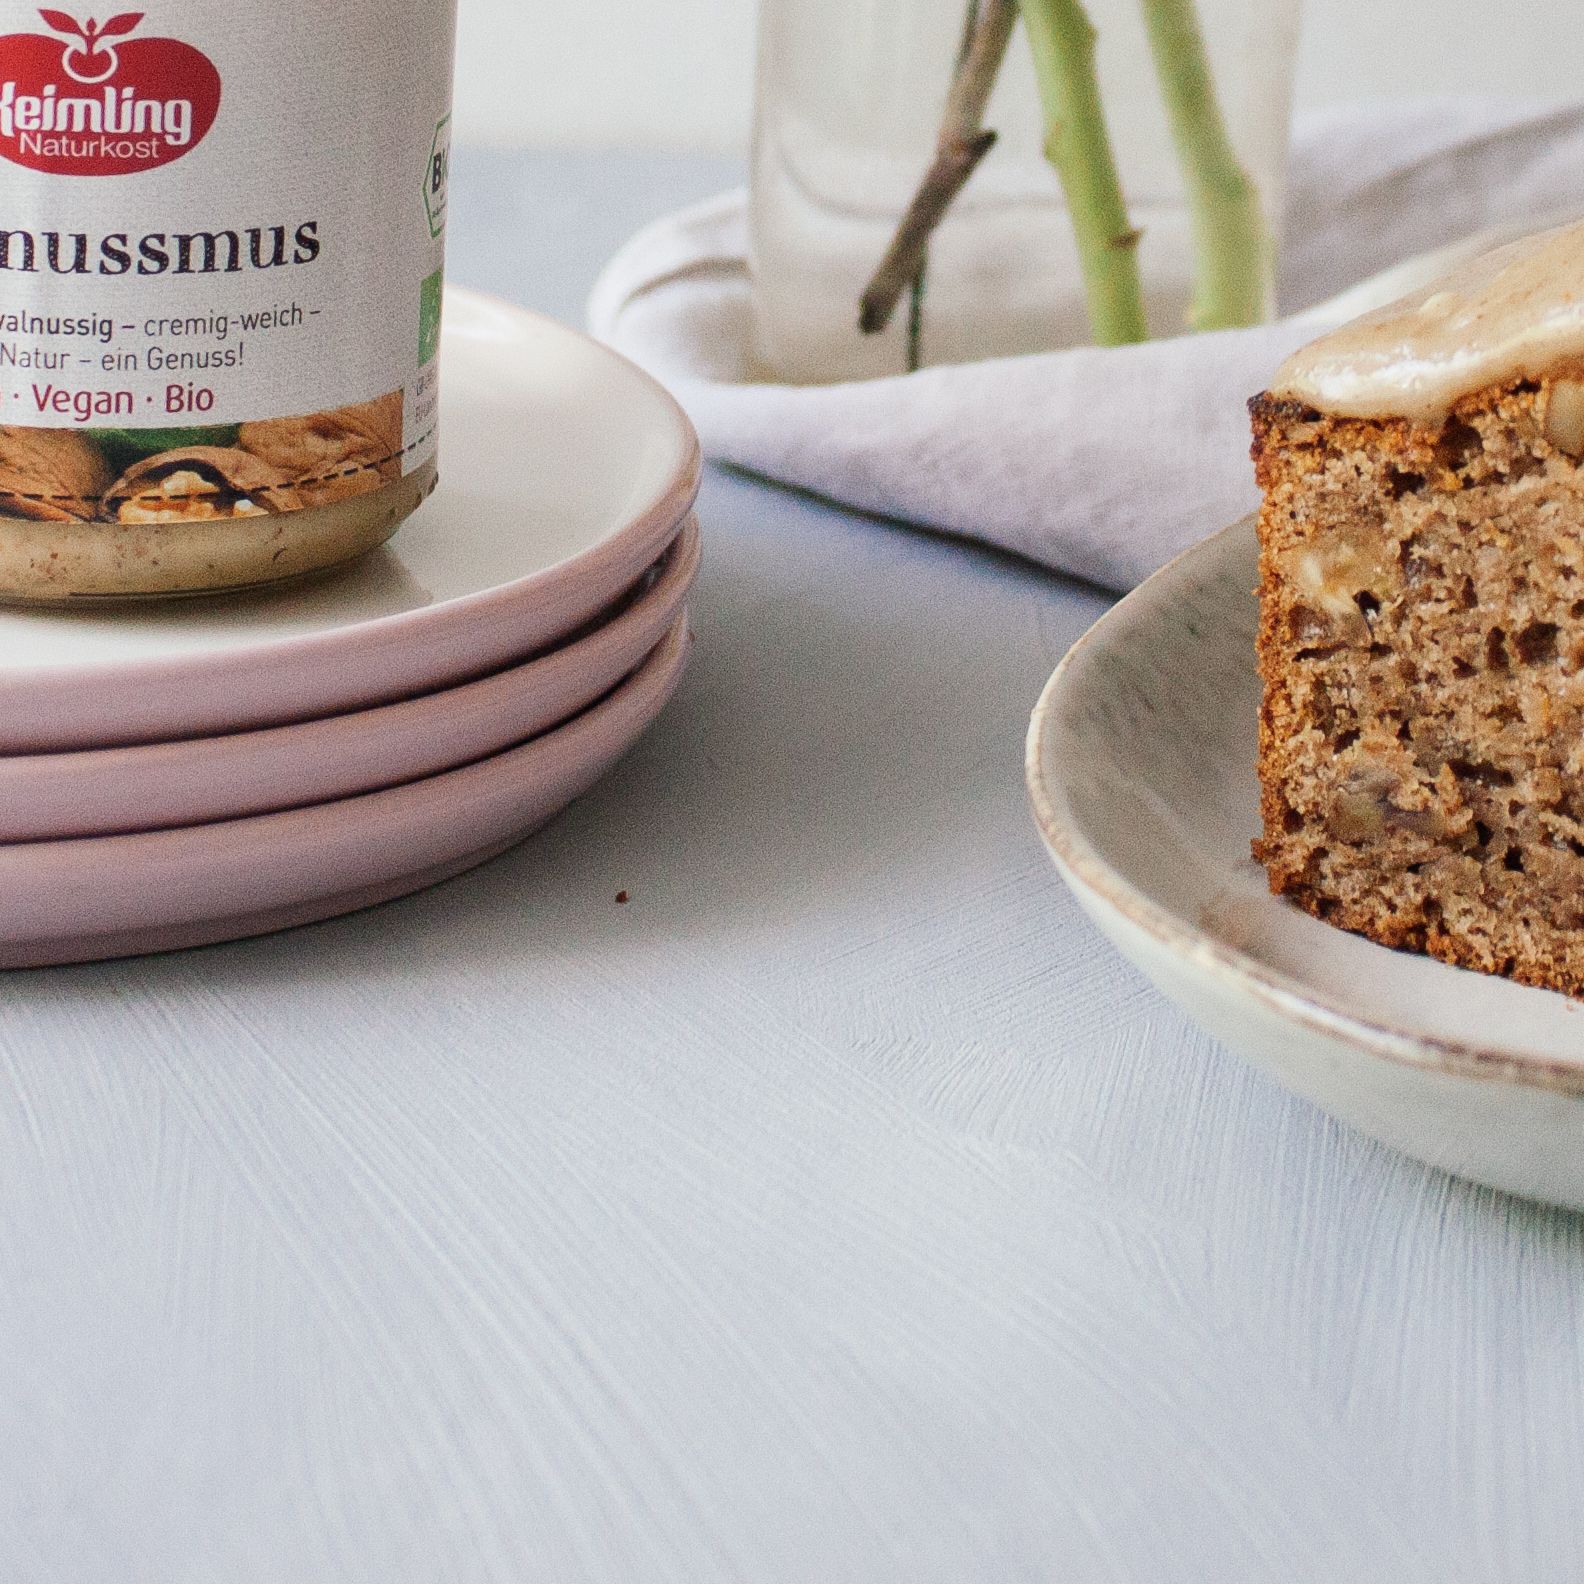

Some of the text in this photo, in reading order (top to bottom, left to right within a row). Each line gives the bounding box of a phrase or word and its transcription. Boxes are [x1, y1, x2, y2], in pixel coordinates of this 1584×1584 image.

[19, 132, 160, 160] Naturkost
[144, 303, 304, 340] cremig-weich
[0, 342, 70, 371] Natur
[101, 348, 138, 371] ein
[147, 342, 245, 371] Genuss!
[31, 384, 134, 422] Vegan
[165, 381, 215, 413] Bio
